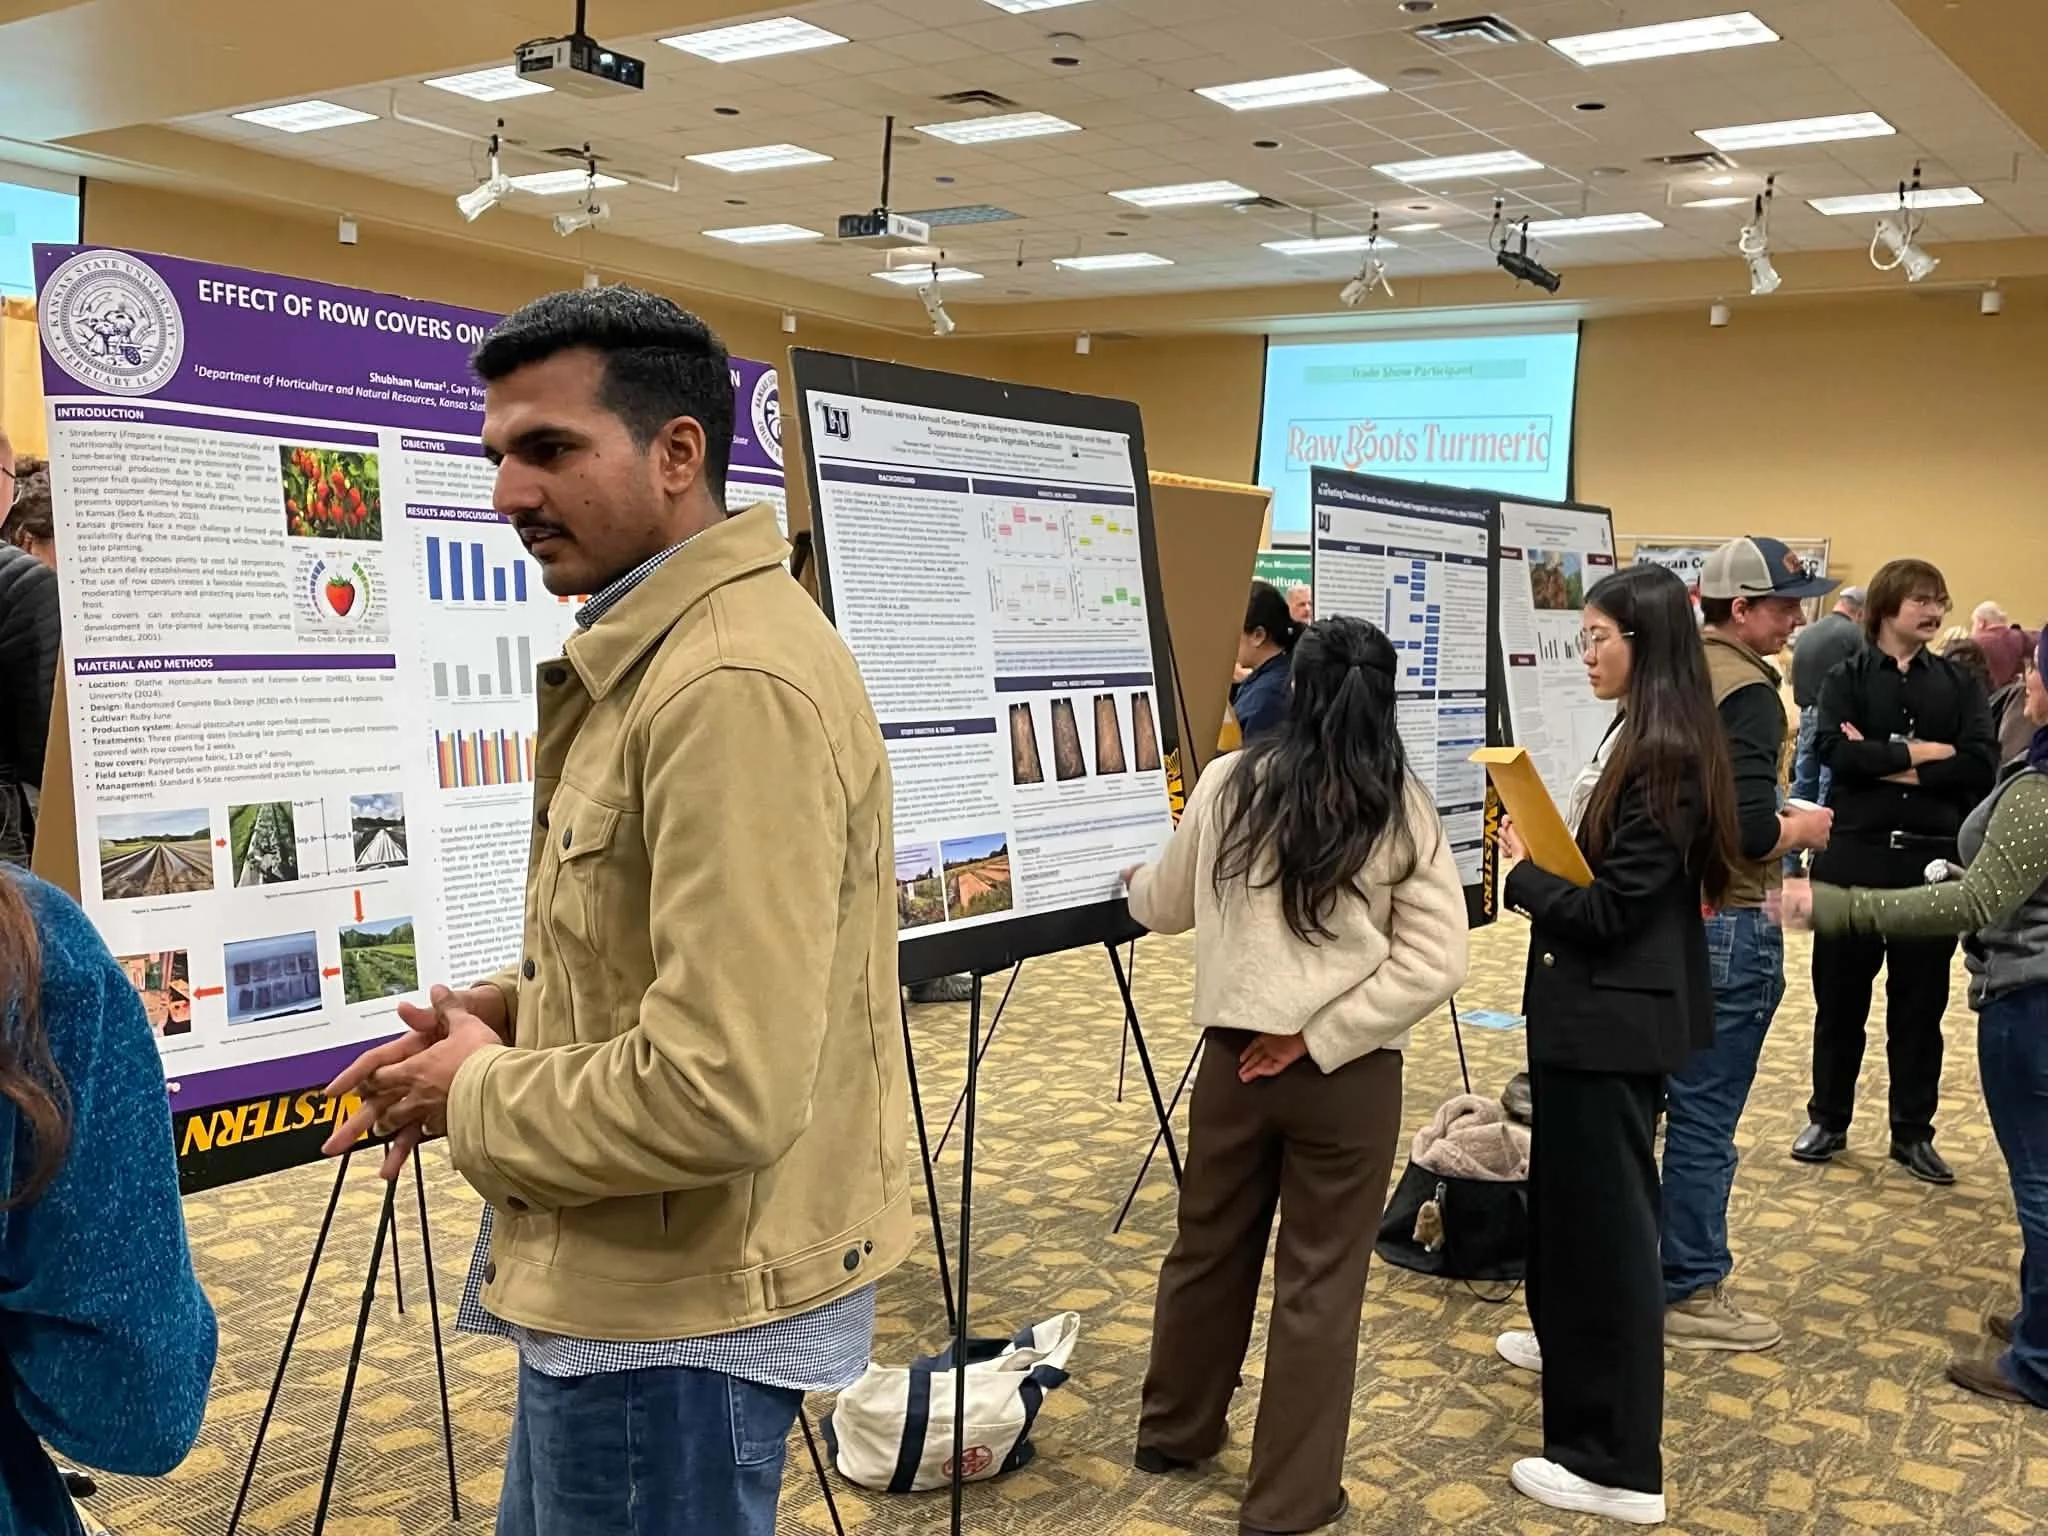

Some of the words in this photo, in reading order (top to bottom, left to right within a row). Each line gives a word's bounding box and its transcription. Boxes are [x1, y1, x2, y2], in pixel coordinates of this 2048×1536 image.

[50, 278, 72, 326] KANSAS
[76, 260, 120, 274] STATE
[198, 279, 278, 312] EFFECT
[284, 294, 313, 318] OF
[318, 300, 369, 327] ROW
[375, 310, 451, 341] COVERS
[456, 323, 485, 344] ON
[61, 348, 130, 387] FEBRUARY
[1353, 365, 1380, 378] Trade
[1382, 366, 1412, 377] Show
[1414, 364, 1473, 379] Participant
[263, 374, 275, 388] of
[276, 376, 333, 393] Horticulture
[336, 384, 354, 396] and
[356, 386, 390, 400] Natural
[392, 391, 437, 408] Resources,
[439, 398, 468, 410] Kansas
[369, 372, 413, 388] Shubham
[451, 383, 470, 398] Cary
[58, 408, 144, 420] INTRODUCTION
[402, 440, 446, 451] OBJECTIVES
[1288, 424, 1342, 462] Raw
[1342, 419, 1418, 470] Roots
[1423, 422, 1549, 463] Turmeric
[407, 506, 438, 517] RESULTS
[440, 508, 456, 518] AND
[457, 510, 499, 521] DISCUSSION
[77, 660, 134, 672] MATERIAL
[137, 660, 162, 670] AND
[164, 658, 214, 669] METHODS
[88, 681, 129, 689] Location:
[92, 725, 140, 734] Production
[96, 780, 158, 790] Management:
[180, 1089, 369, 1157] WESTERN
